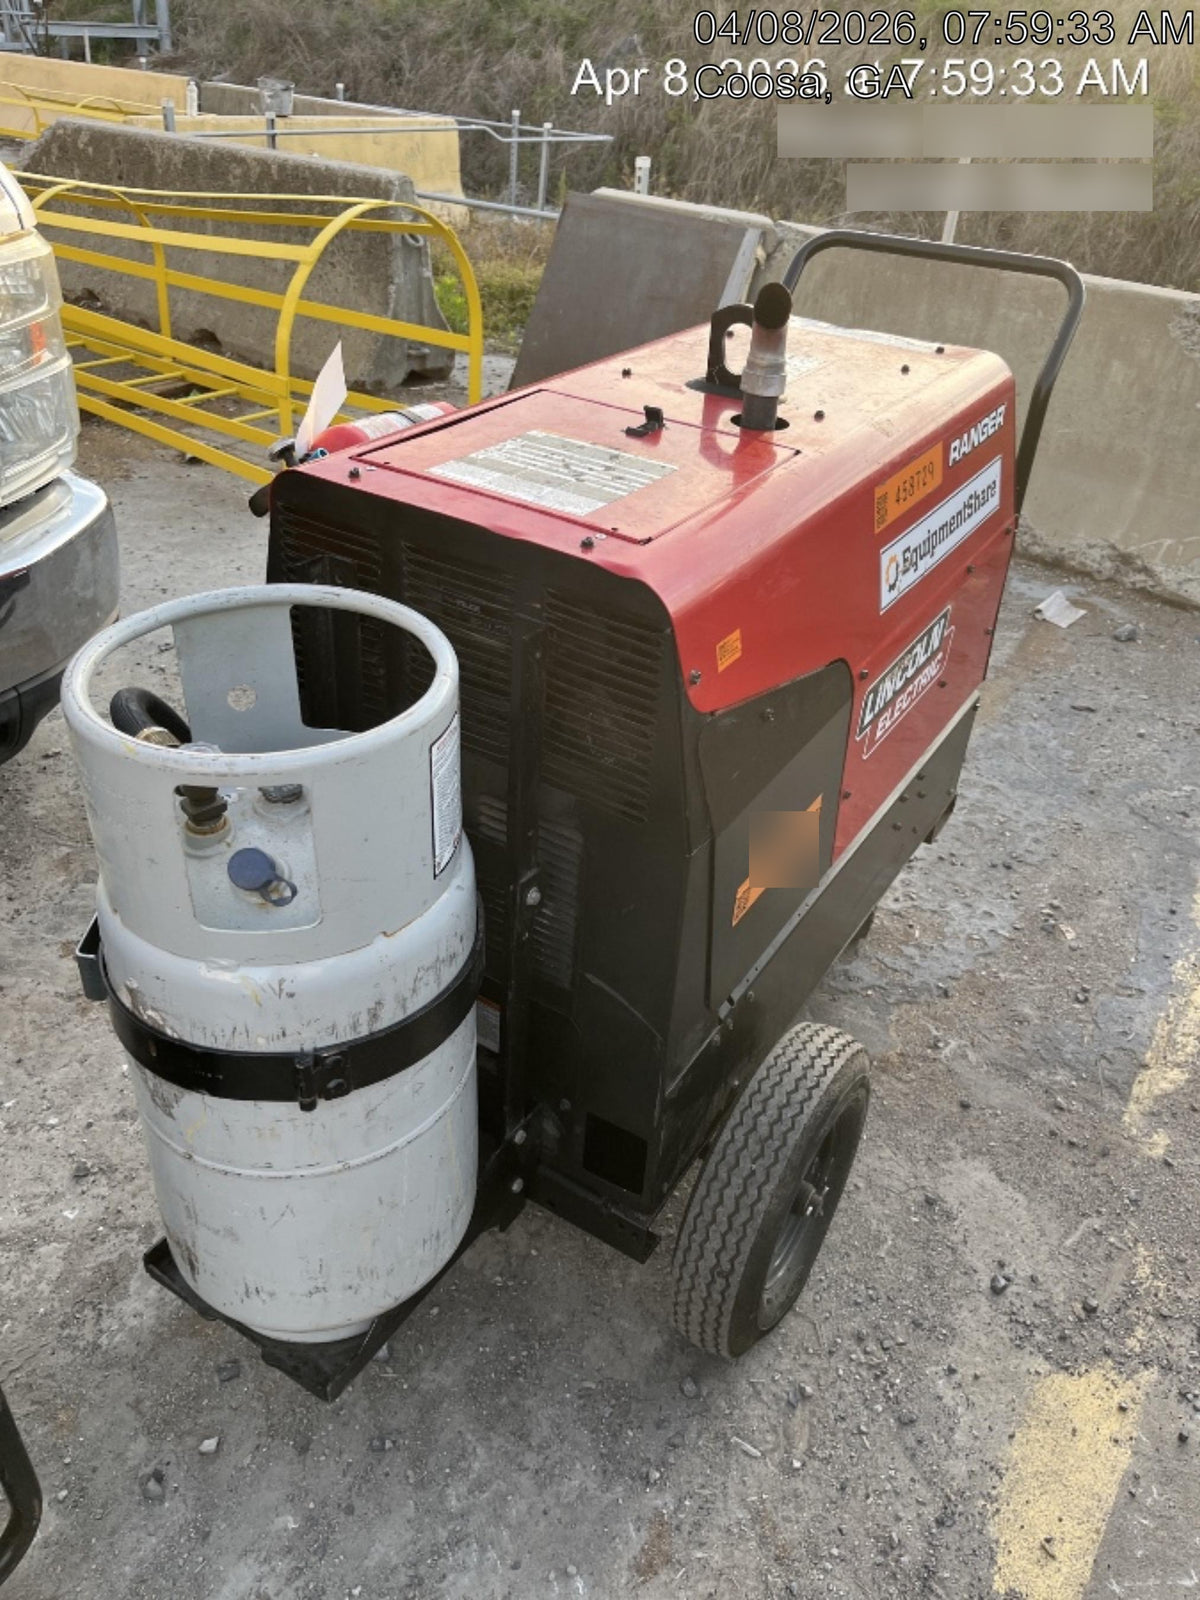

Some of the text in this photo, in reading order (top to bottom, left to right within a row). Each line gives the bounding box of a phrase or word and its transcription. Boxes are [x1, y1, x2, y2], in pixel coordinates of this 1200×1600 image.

[949, 404, 1006, 467] RANGER
[902, 479, 997, 576] EquipmentShare
[863, 618, 946, 728] LINCOLN
[876, 652, 943, 740] ELECTRIC
